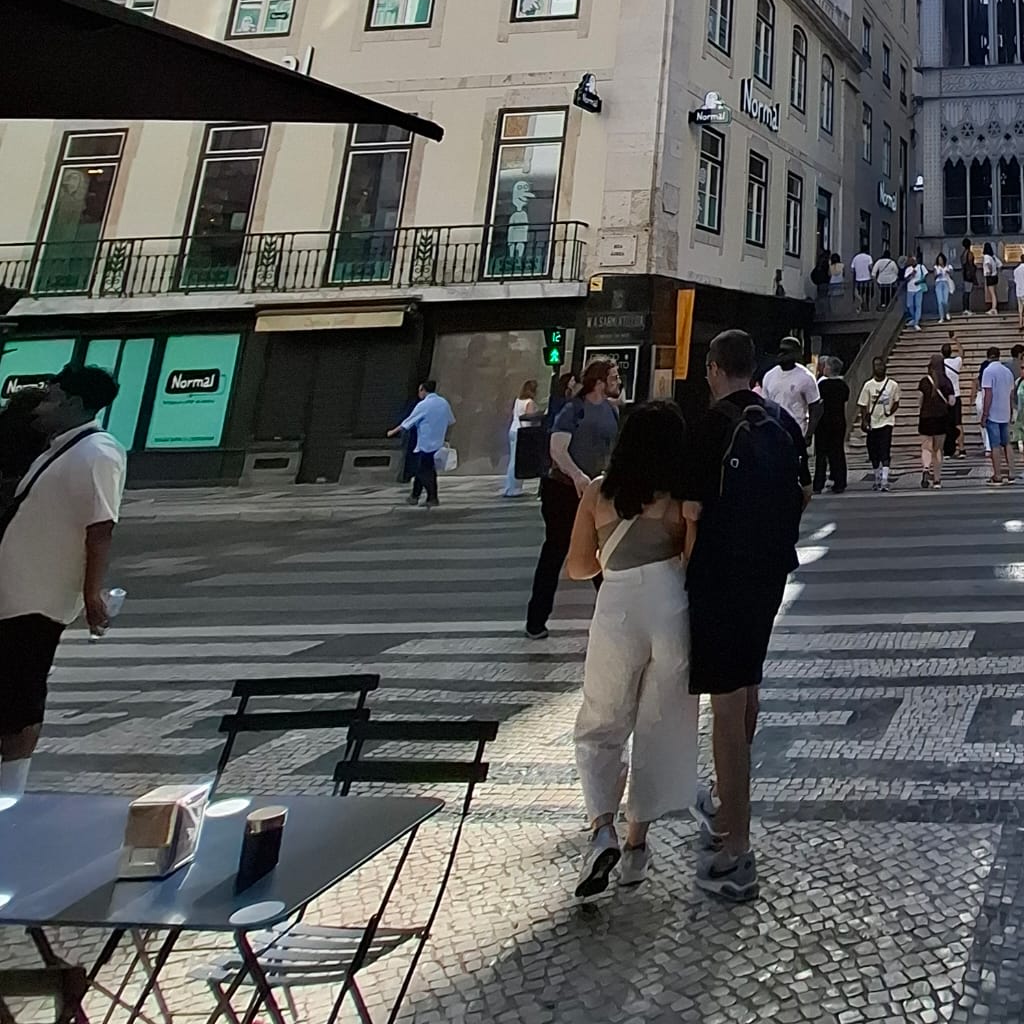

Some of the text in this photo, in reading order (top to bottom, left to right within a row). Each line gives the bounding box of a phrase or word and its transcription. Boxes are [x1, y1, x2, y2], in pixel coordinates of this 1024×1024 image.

[742, 78, 780, 131] Normal
[696, 111, 726, 121] Normal
[552, 331, 561, 343] 12
[171, 374, 215, 389] Normal
